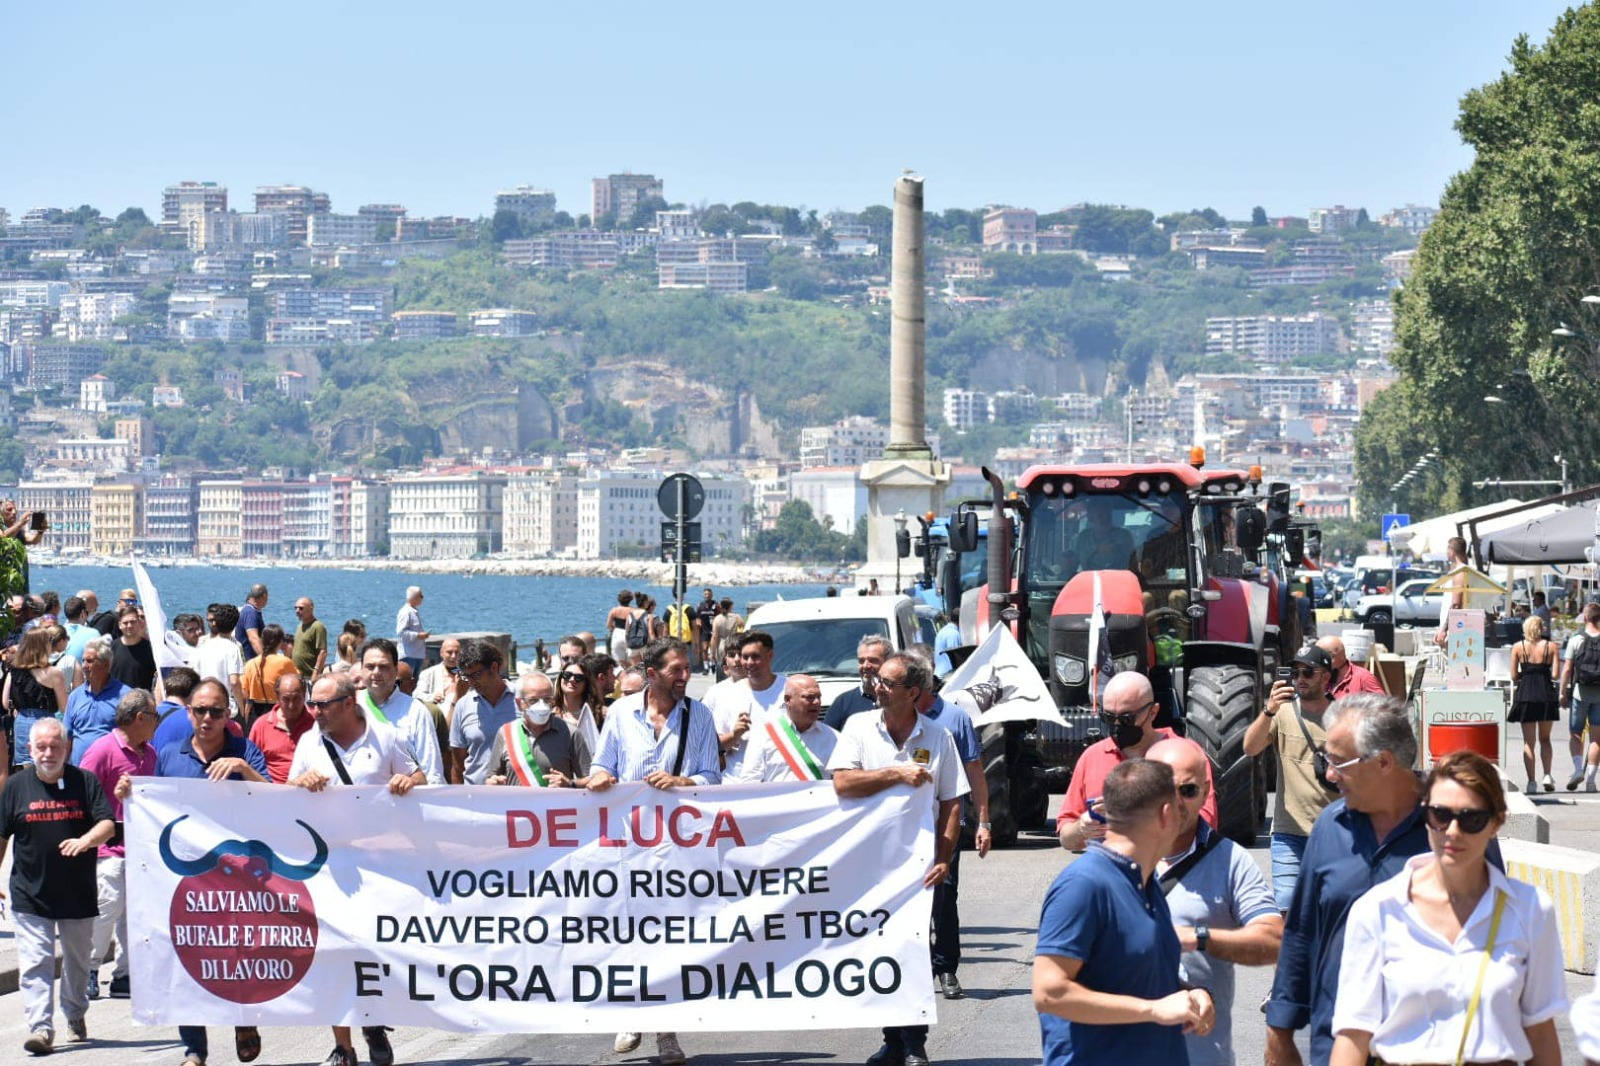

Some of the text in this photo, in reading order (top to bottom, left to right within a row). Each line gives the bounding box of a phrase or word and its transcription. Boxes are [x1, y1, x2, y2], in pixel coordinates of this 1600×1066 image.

[26, 813, 52, 822] DALLE
[506, 805, 746, 848] DE LUCA
[427, 866, 830, 898] VOGLIAMO RISOLVERE
[186, 891, 299, 913] SALVIAMO LE
[175, 925, 314, 948] BUFALE E TERRA
[376, 908, 891, 944] DAVVERO BRUCELLA E TBC?
[201, 959, 293, 981] DI LAVORO
[354, 956, 902, 1002] E' L'ORA DEL DIALOGO
